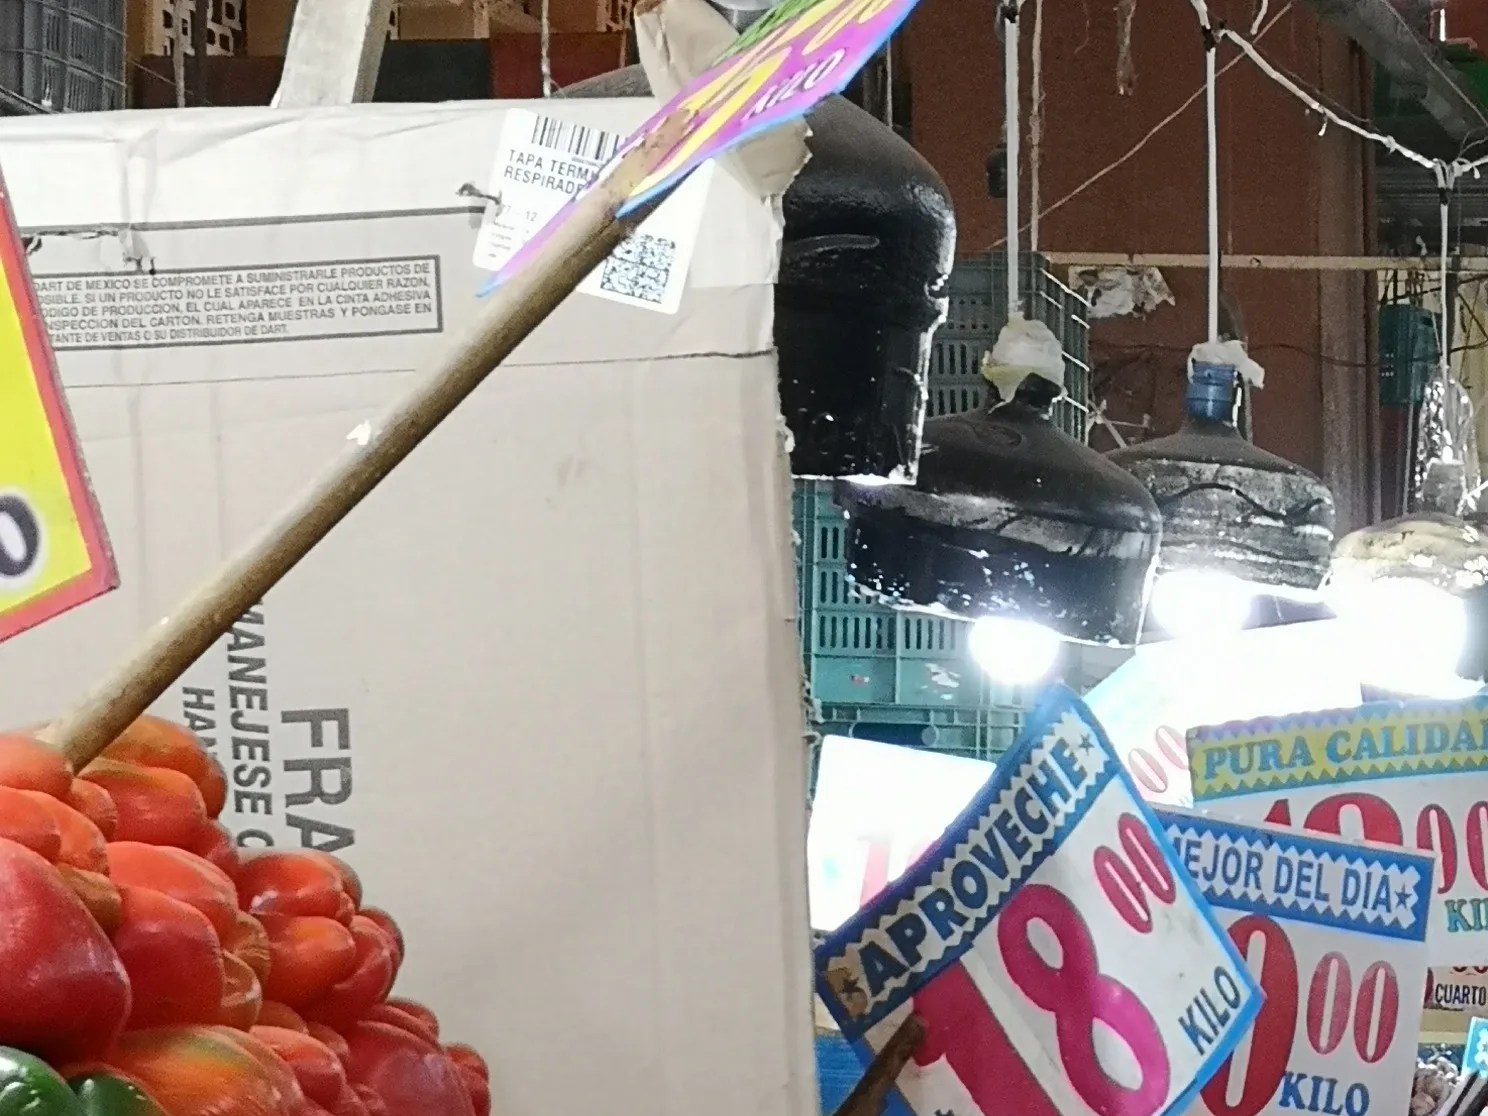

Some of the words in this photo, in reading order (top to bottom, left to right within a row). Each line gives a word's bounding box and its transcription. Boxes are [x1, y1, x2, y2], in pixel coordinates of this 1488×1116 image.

[509, 149, 543, 169] TAPA
[33, 281, 63, 292] DART
[67, 280, 82, 291] DE
[86, 278, 130, 290] MEXICO
[133, 277, 149, 289] SE
[152, 274, 232, 288] COMPROMETE
[236, 274, 244, 284] A
[247, 268, 338, 284] SUMINISTRARLE
[341, 264, 411, 278] PRODUCTOS
[414, 263, 430, 274] DE
[100, 292, 115, 304] UN
[120, 289, 183, 302] PRODUCTO
[187, 288, 203, 300] NO
[207, 287, 221, 299] LE
[225, 284, 286, 298] SATISFACE
[289, 282, 314, 294] POR
[317, 278, 383, 293] CUALQUIER
[82, 305, 98, 316] DE
[187, 301, 200, 313] EL
[204, 300, 233, 312] CUAL
[238, 298, 292, 310] APARECE
[299, 297, 315, 307] EN
[318, 296, 332, 306] LA
[335, 294, 370, 305] CINTA
[373, 290, 431, 303] ADHESIVA
[122, 317, 146, 328] DEL
[206, 311, 265, 324] RETENGA
[268, 308, 336, 322] MUESTRAS
[341, 307, 349, 317] Y
[351, 303, 411, 317] PONGASE
[415, 303, 431, 313] EN
[85, 332, 98, 343] DE
[101, 330, 140, 342] VENTAS
[154, 329, 167, 340] SU
[170, 325, 243, 339] DISTRIBUIDOR
[244, 325, 258, 336] DE
[1204, 735, 1315, 781] PURA
[857, 737, 1088, 998] APROVECHE
[1273, 856, 1330, 903] DEL
[1341, 869, 1392, 913] DIA
[1306, 951, 1399, 1063] 00
[1435, 983, 1487, 1006] CUARTO
[1177, 965, 1242, 1057] KILO
